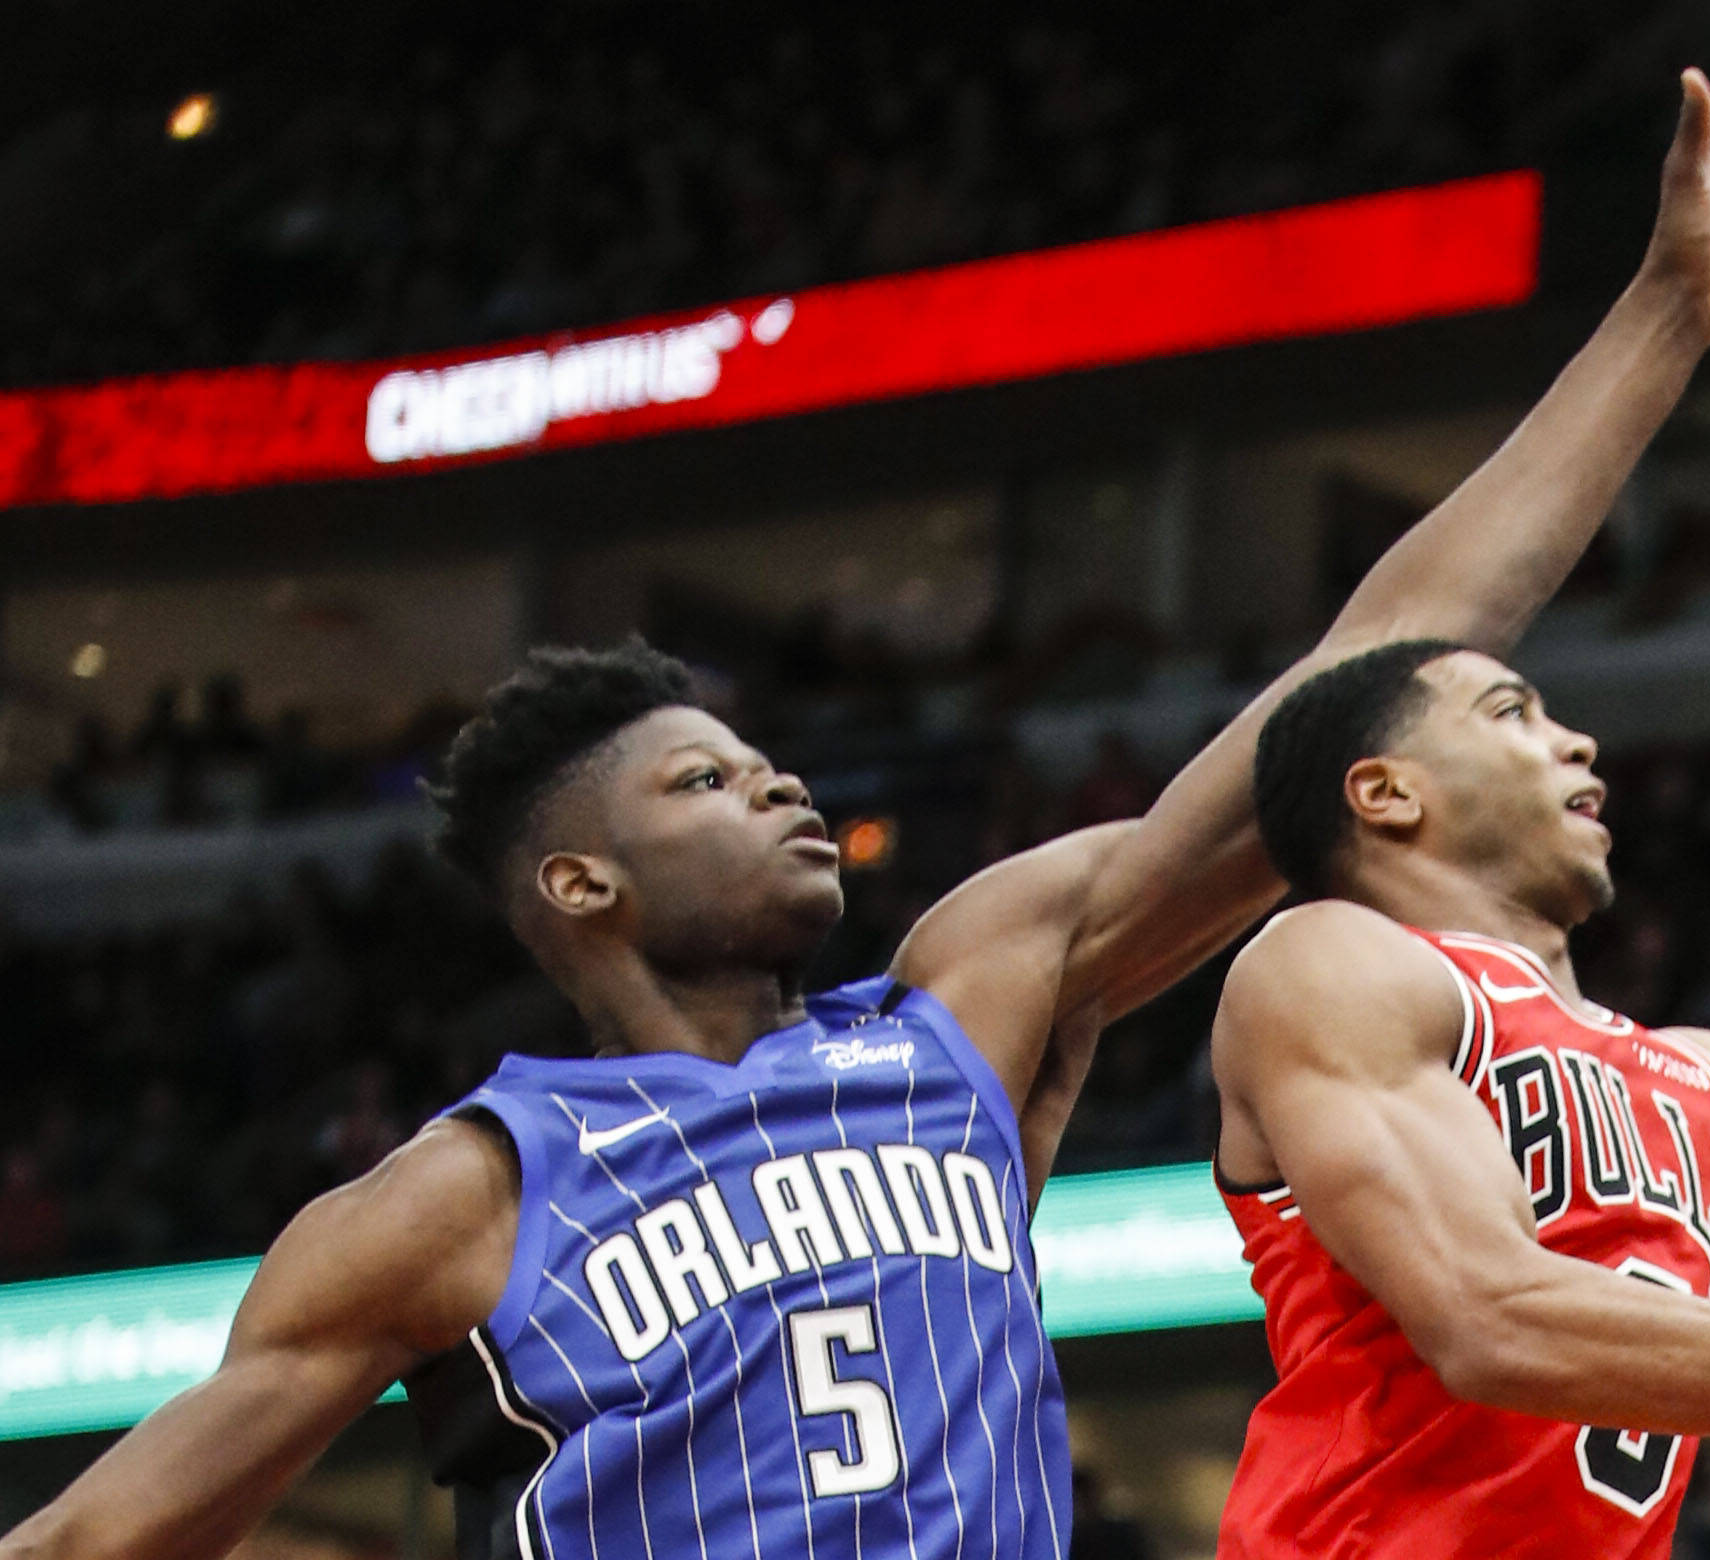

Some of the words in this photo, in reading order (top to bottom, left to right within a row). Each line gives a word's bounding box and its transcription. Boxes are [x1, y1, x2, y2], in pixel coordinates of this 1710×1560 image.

[812, 1039, 915, 1070] Disney
[584, 1144, 1013, 1363] ORLANDO
[788, 1303, 902, 1499] 5
